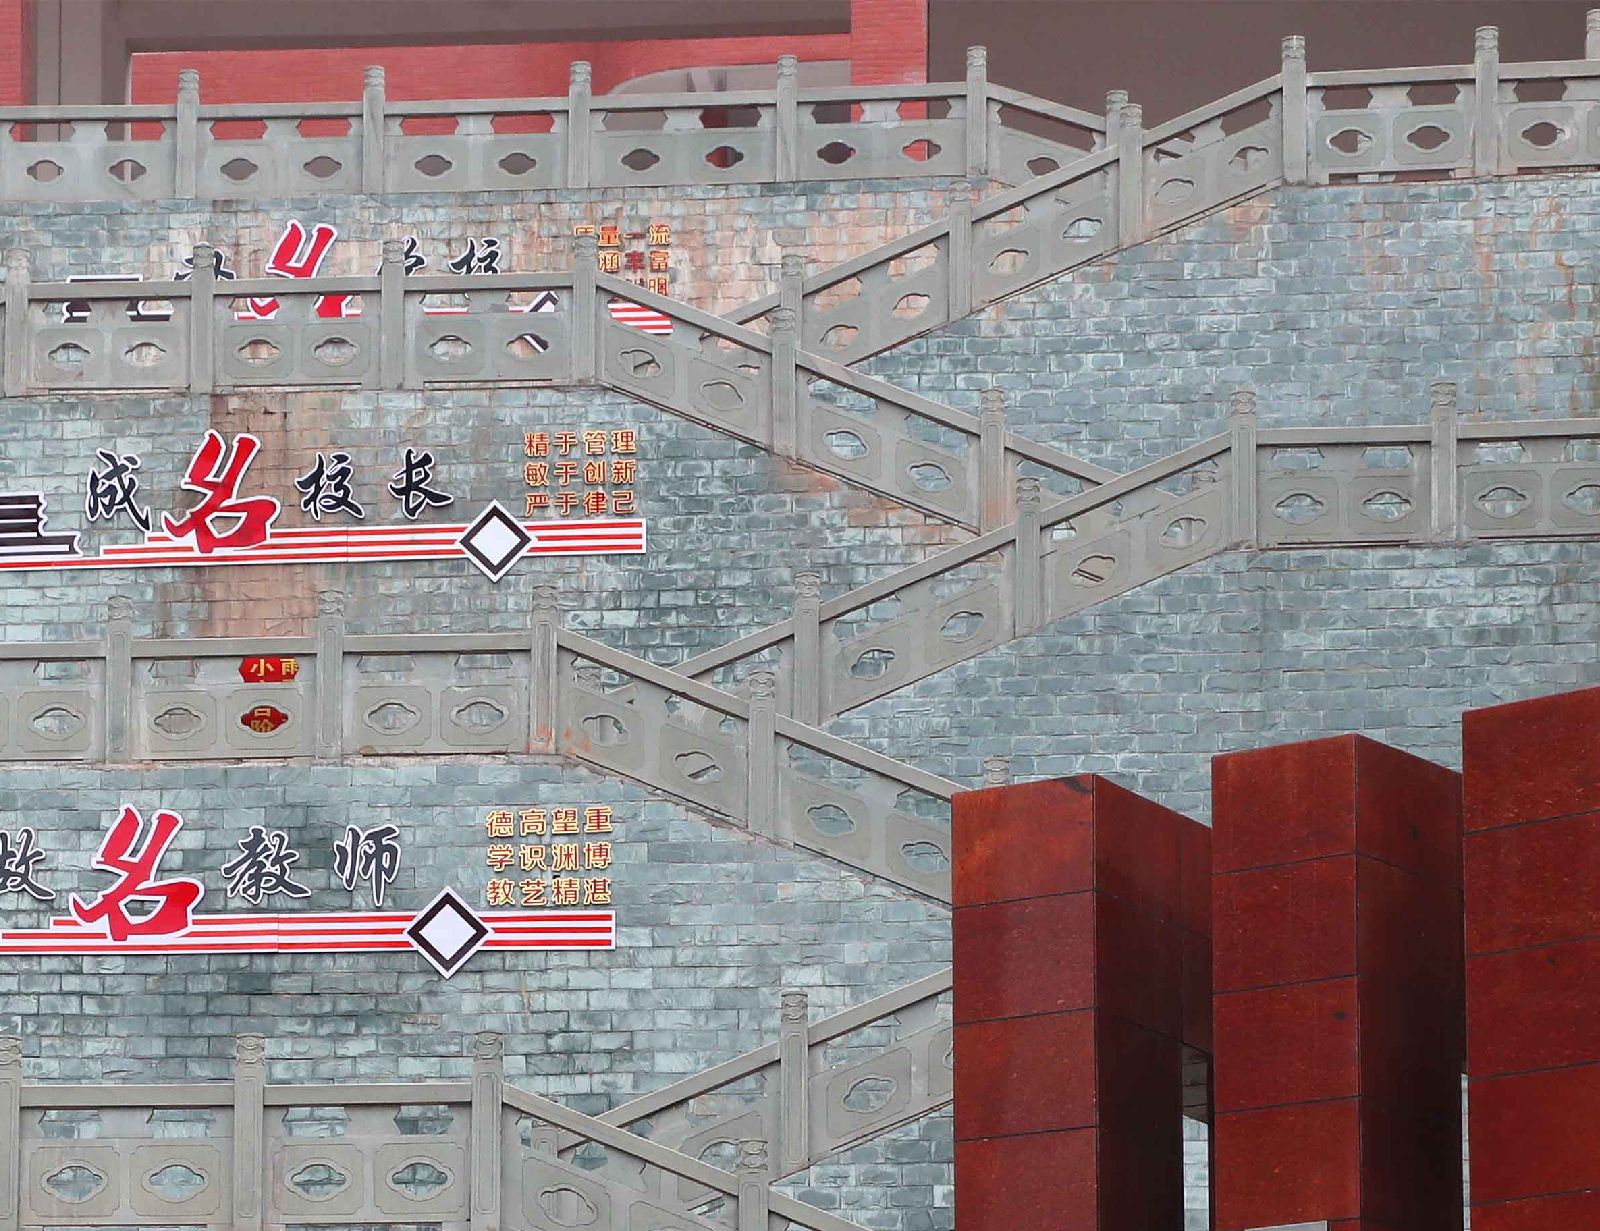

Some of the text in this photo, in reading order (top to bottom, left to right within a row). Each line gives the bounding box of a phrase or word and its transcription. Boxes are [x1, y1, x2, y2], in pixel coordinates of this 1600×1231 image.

[524, 429, 636, 457] 精于管理
[524, 459, 636, 487] 敏于创新
[86, 428, 453, 554] 成名校长
[524, 489, 636, 517] 严于律己
[486, 806, 612, 837] 德高望重
[486, 842, 611, 871] 学识渊博
[486, 877, 612, 906] 教艺精湛
